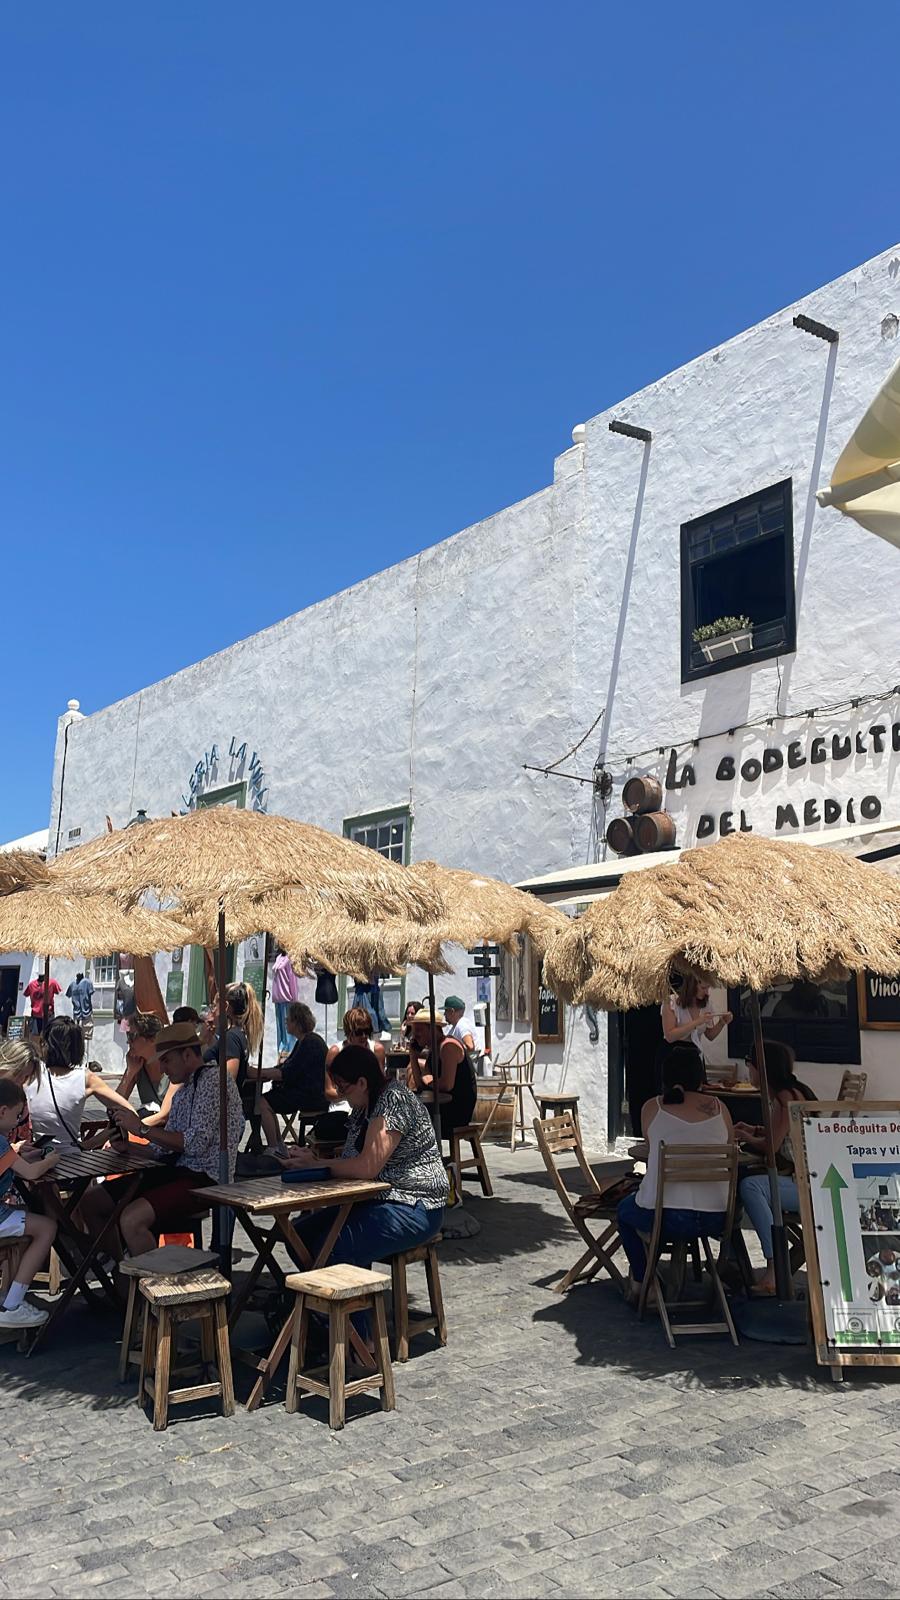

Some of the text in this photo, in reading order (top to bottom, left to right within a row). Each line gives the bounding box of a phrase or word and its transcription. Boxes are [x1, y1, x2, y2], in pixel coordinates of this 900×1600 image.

[665, 748, 696, 790] LA
[697, 795, 882, 838] DEL MEDIO
[870, 977, 900, 998] Vino
[818, 1123, 830, 1133] La
[833, 1123, 887, 1135] Bodeguita
[846, 1145, 878, 1157] Tapas
[880, 1147, 887, 1156] y
